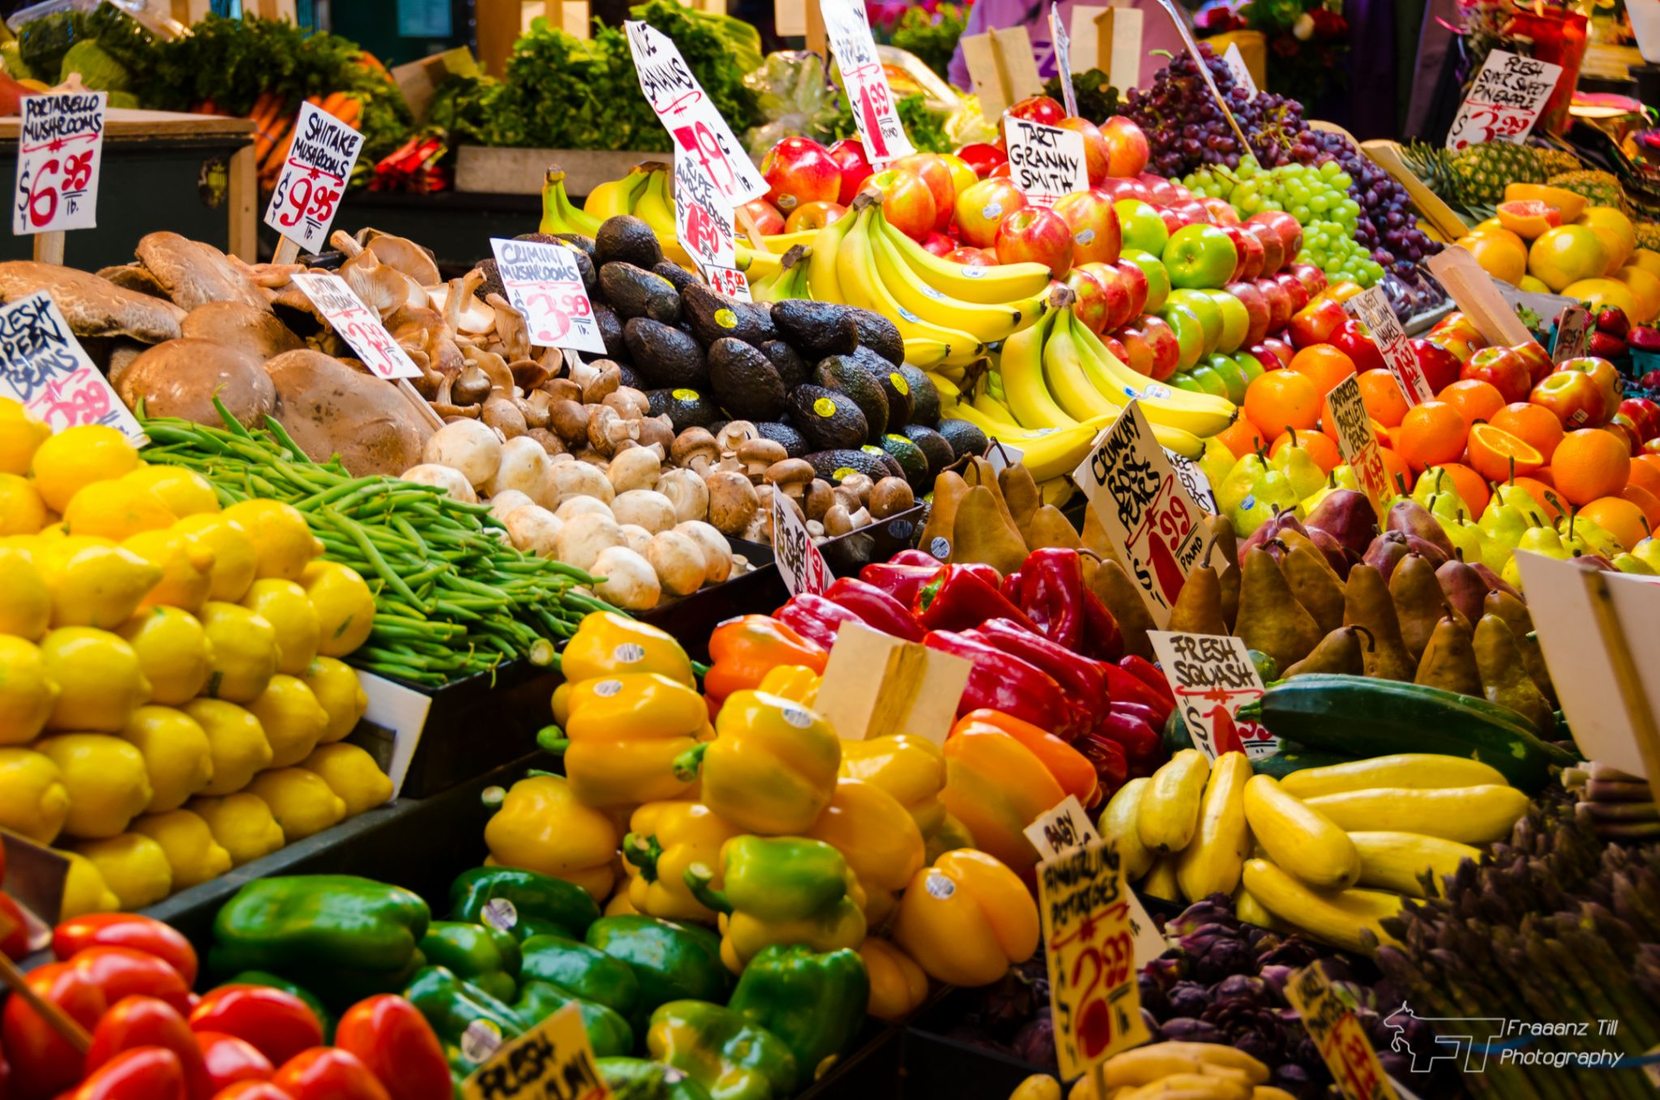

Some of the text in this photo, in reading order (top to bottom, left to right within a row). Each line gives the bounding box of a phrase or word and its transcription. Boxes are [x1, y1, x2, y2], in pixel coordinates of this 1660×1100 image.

[26, 95, 99, 122] PORTABELLO
[23, 113, 102, 143] MUSHROOMS
[1018, 122, 1063, 149] TART
[291, 137, 349, 180] MUSHROOMS
[1010, 144, 1078, 180] GRANNY
[684, 156, 714, 199] RIPE
[1021, 169, 1073, 194] SMITH
[502, 243, 563, 265] CRIMINI
[500, 264, 579, 281] MUSHROOMS
[6, 347, 79, 404] BEANS
[1091, 408, 1141, 488] CRUNCHY
[1107, 444, 1149, 507] BOSC
[1117, 460, 1161, 534] PEARS
[1180, 537, 1204, 576] POUND
[1169, 634, 1240, 664] FRESH
[1173, 660, 1255, 689] SQUASH
